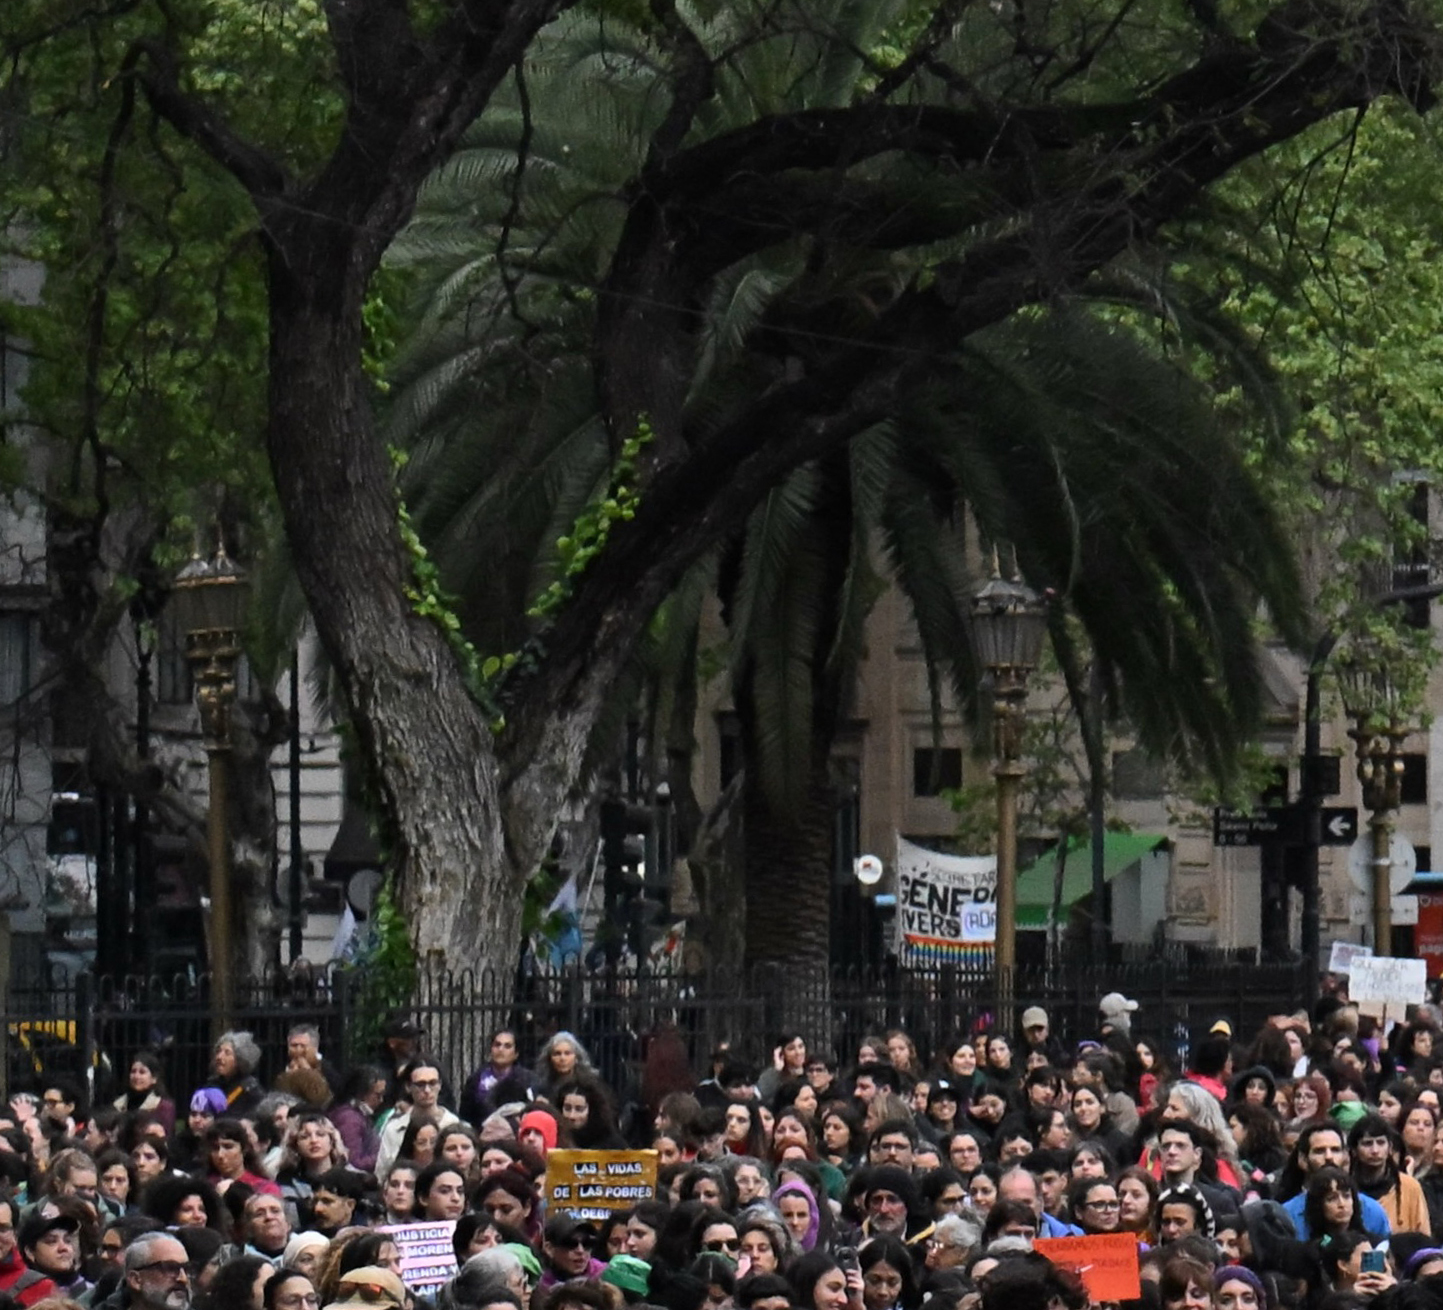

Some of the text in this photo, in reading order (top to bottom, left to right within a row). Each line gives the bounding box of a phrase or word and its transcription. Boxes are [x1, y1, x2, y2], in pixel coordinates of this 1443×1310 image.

[574, 1162, 643, 1175] LAS VIDAS
[553, 1185, 653, 1198] DE LAS POBRES
[396, 1227, 451, 1241] JUSTICIA
[407, 1244, 454, 1257] MOREN
[402, 1265, 448, 1279] RENDA
